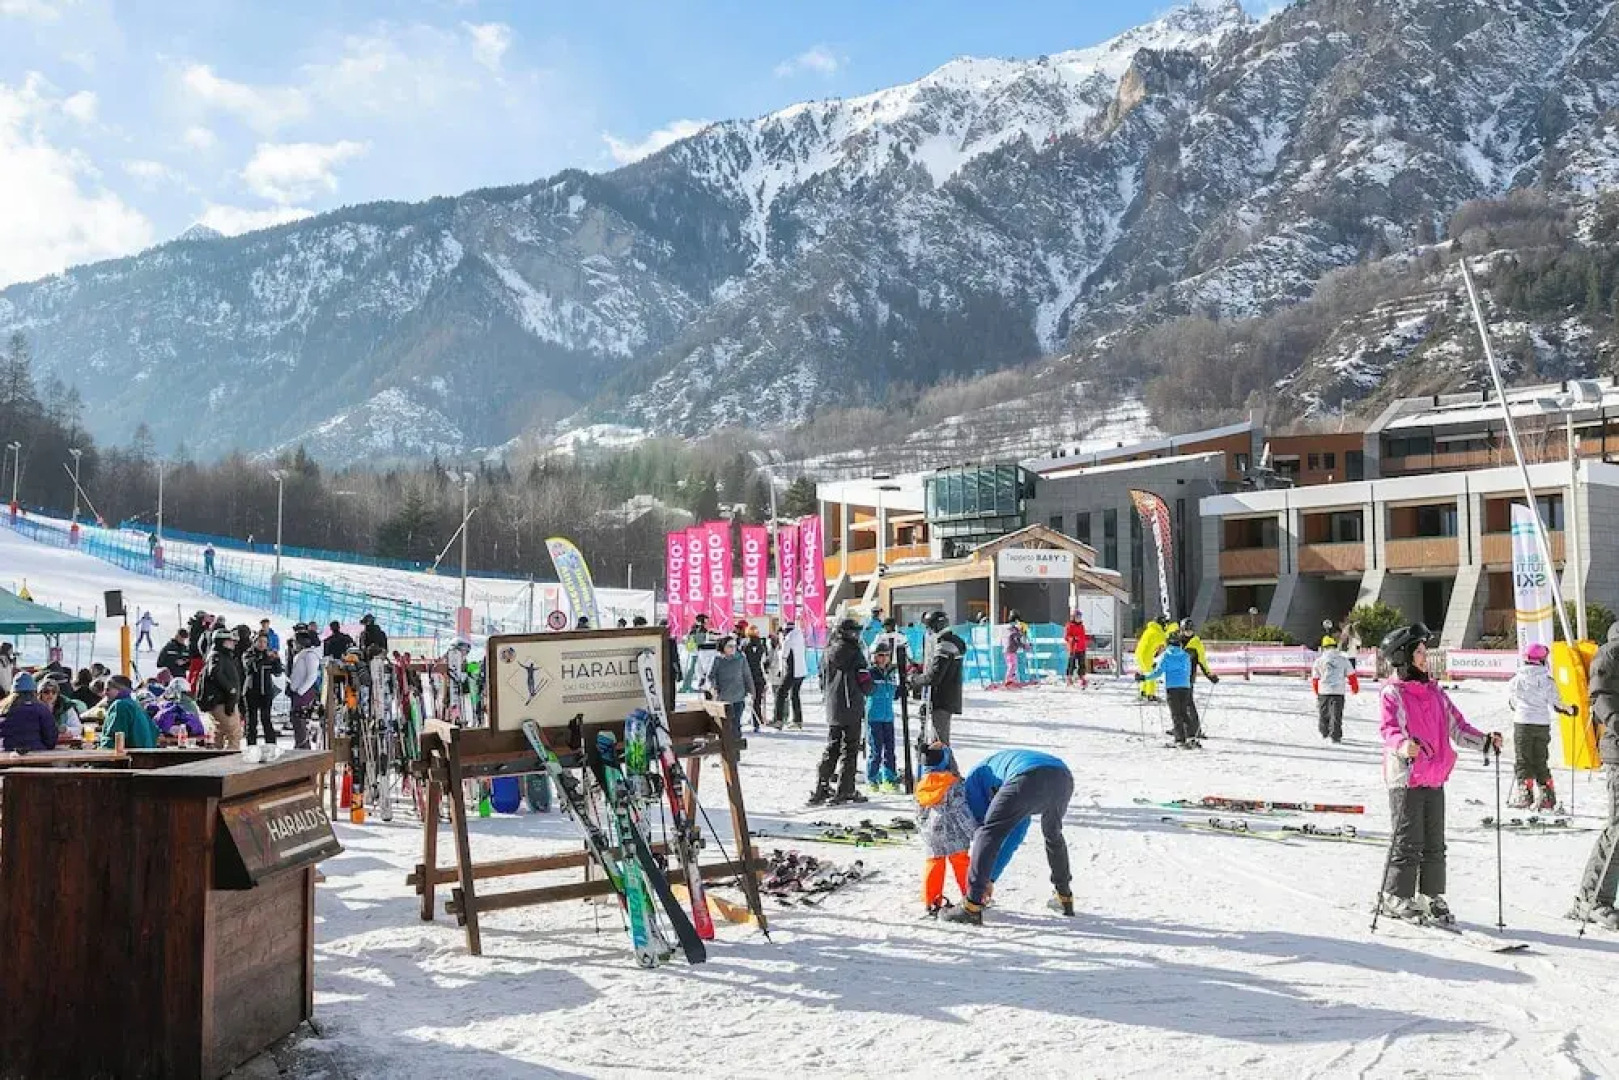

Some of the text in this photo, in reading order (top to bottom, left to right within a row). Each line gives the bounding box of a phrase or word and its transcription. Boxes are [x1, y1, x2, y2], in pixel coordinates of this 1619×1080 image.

[561, 660, 639, 680] HARALD
[579, 679, 638, 690] RESTAURANT
[265, 805, 328, 842] HARALD'S
